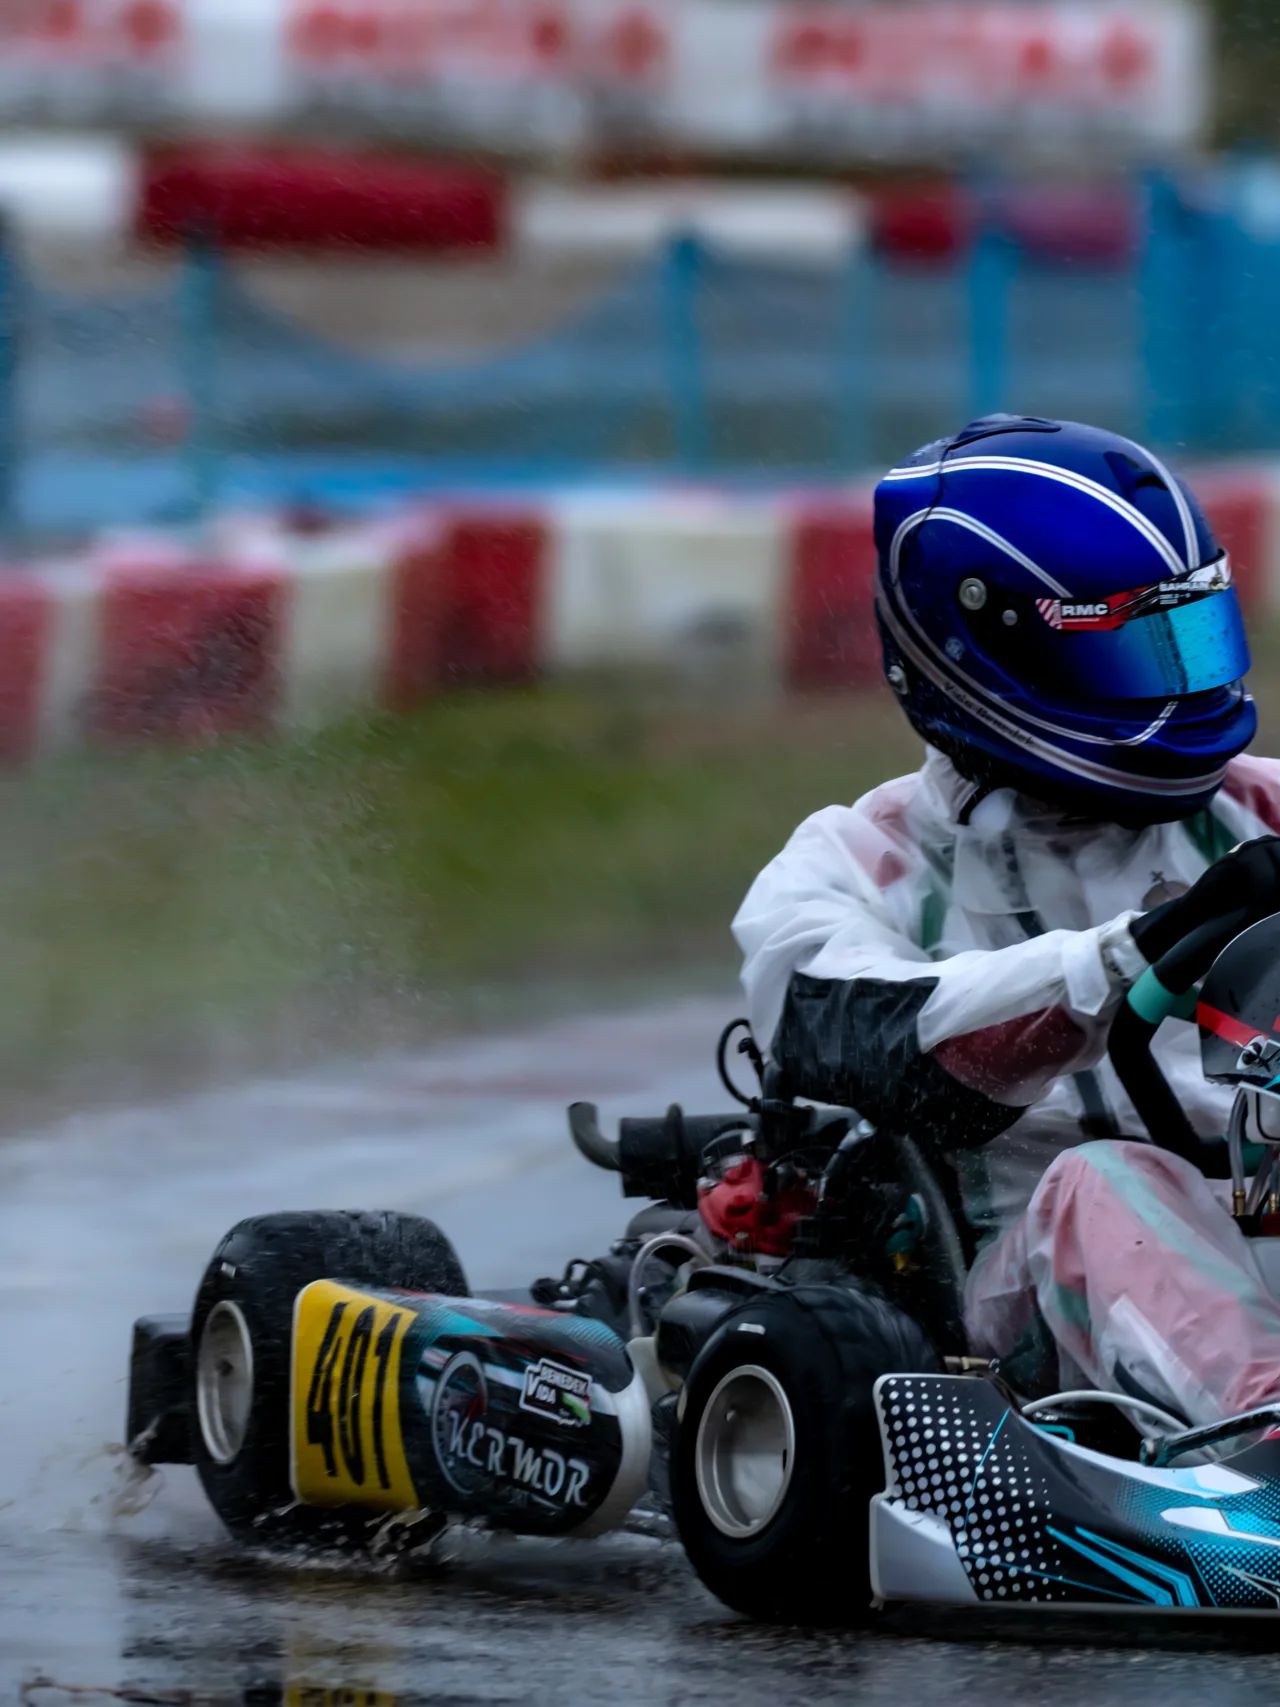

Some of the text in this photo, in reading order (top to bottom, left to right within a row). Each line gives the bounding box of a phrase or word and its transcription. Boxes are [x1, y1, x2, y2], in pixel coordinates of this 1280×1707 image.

[1061, 603, 1108, 616] RMC
[306, 1302, 401, 1490] 401
[449, 1410, 591, 1506] KERMOR
